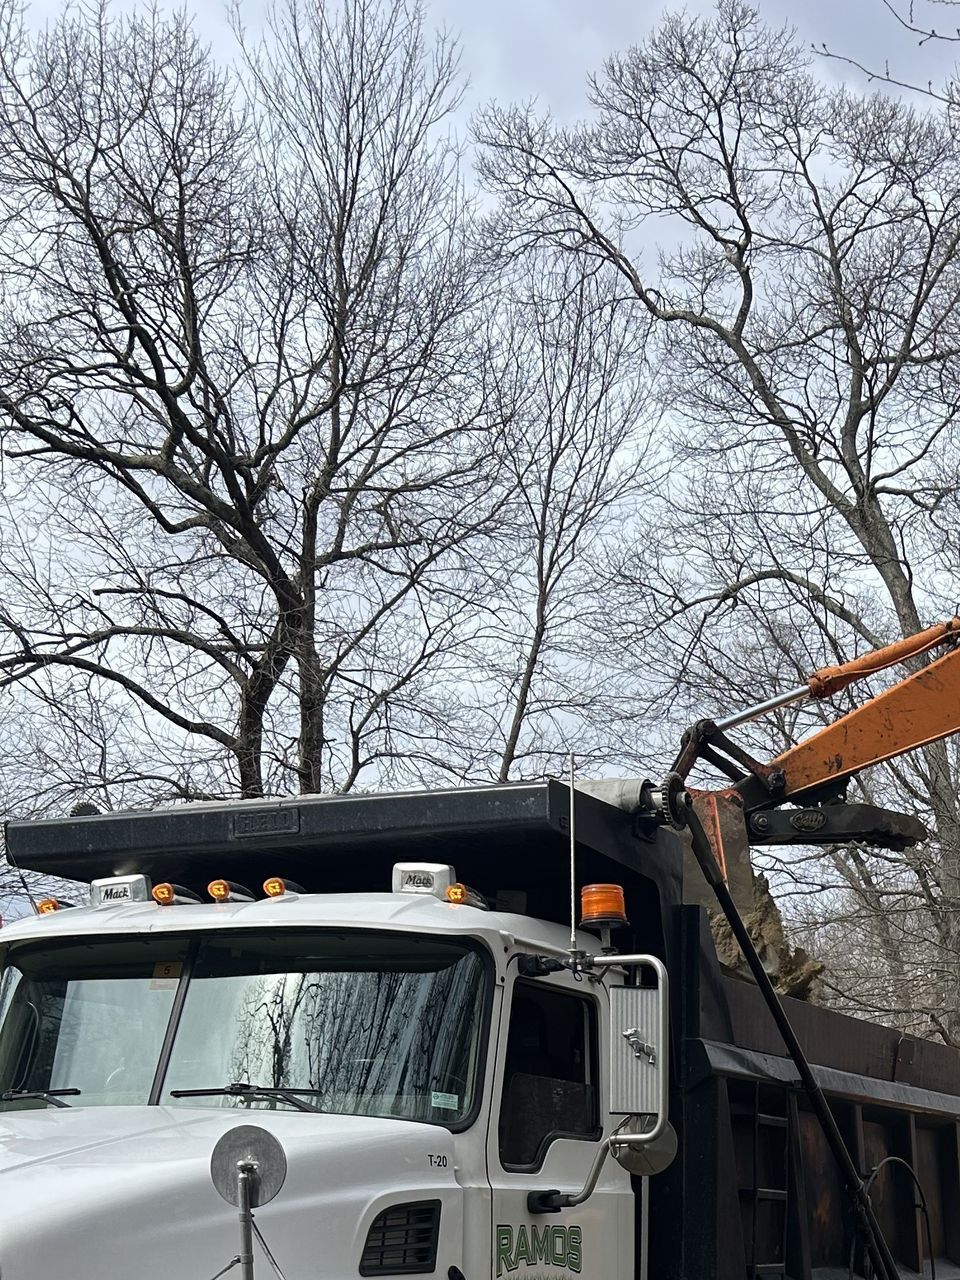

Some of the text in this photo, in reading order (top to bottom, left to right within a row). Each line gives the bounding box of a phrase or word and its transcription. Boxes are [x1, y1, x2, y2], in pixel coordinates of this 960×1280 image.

[405, 874, 433, 888] Mack
[103, 887, 129, 900] Mack
[427, 1154, 448, 1167] T-20
[496, 1224, 582, 1278] RAMOS
